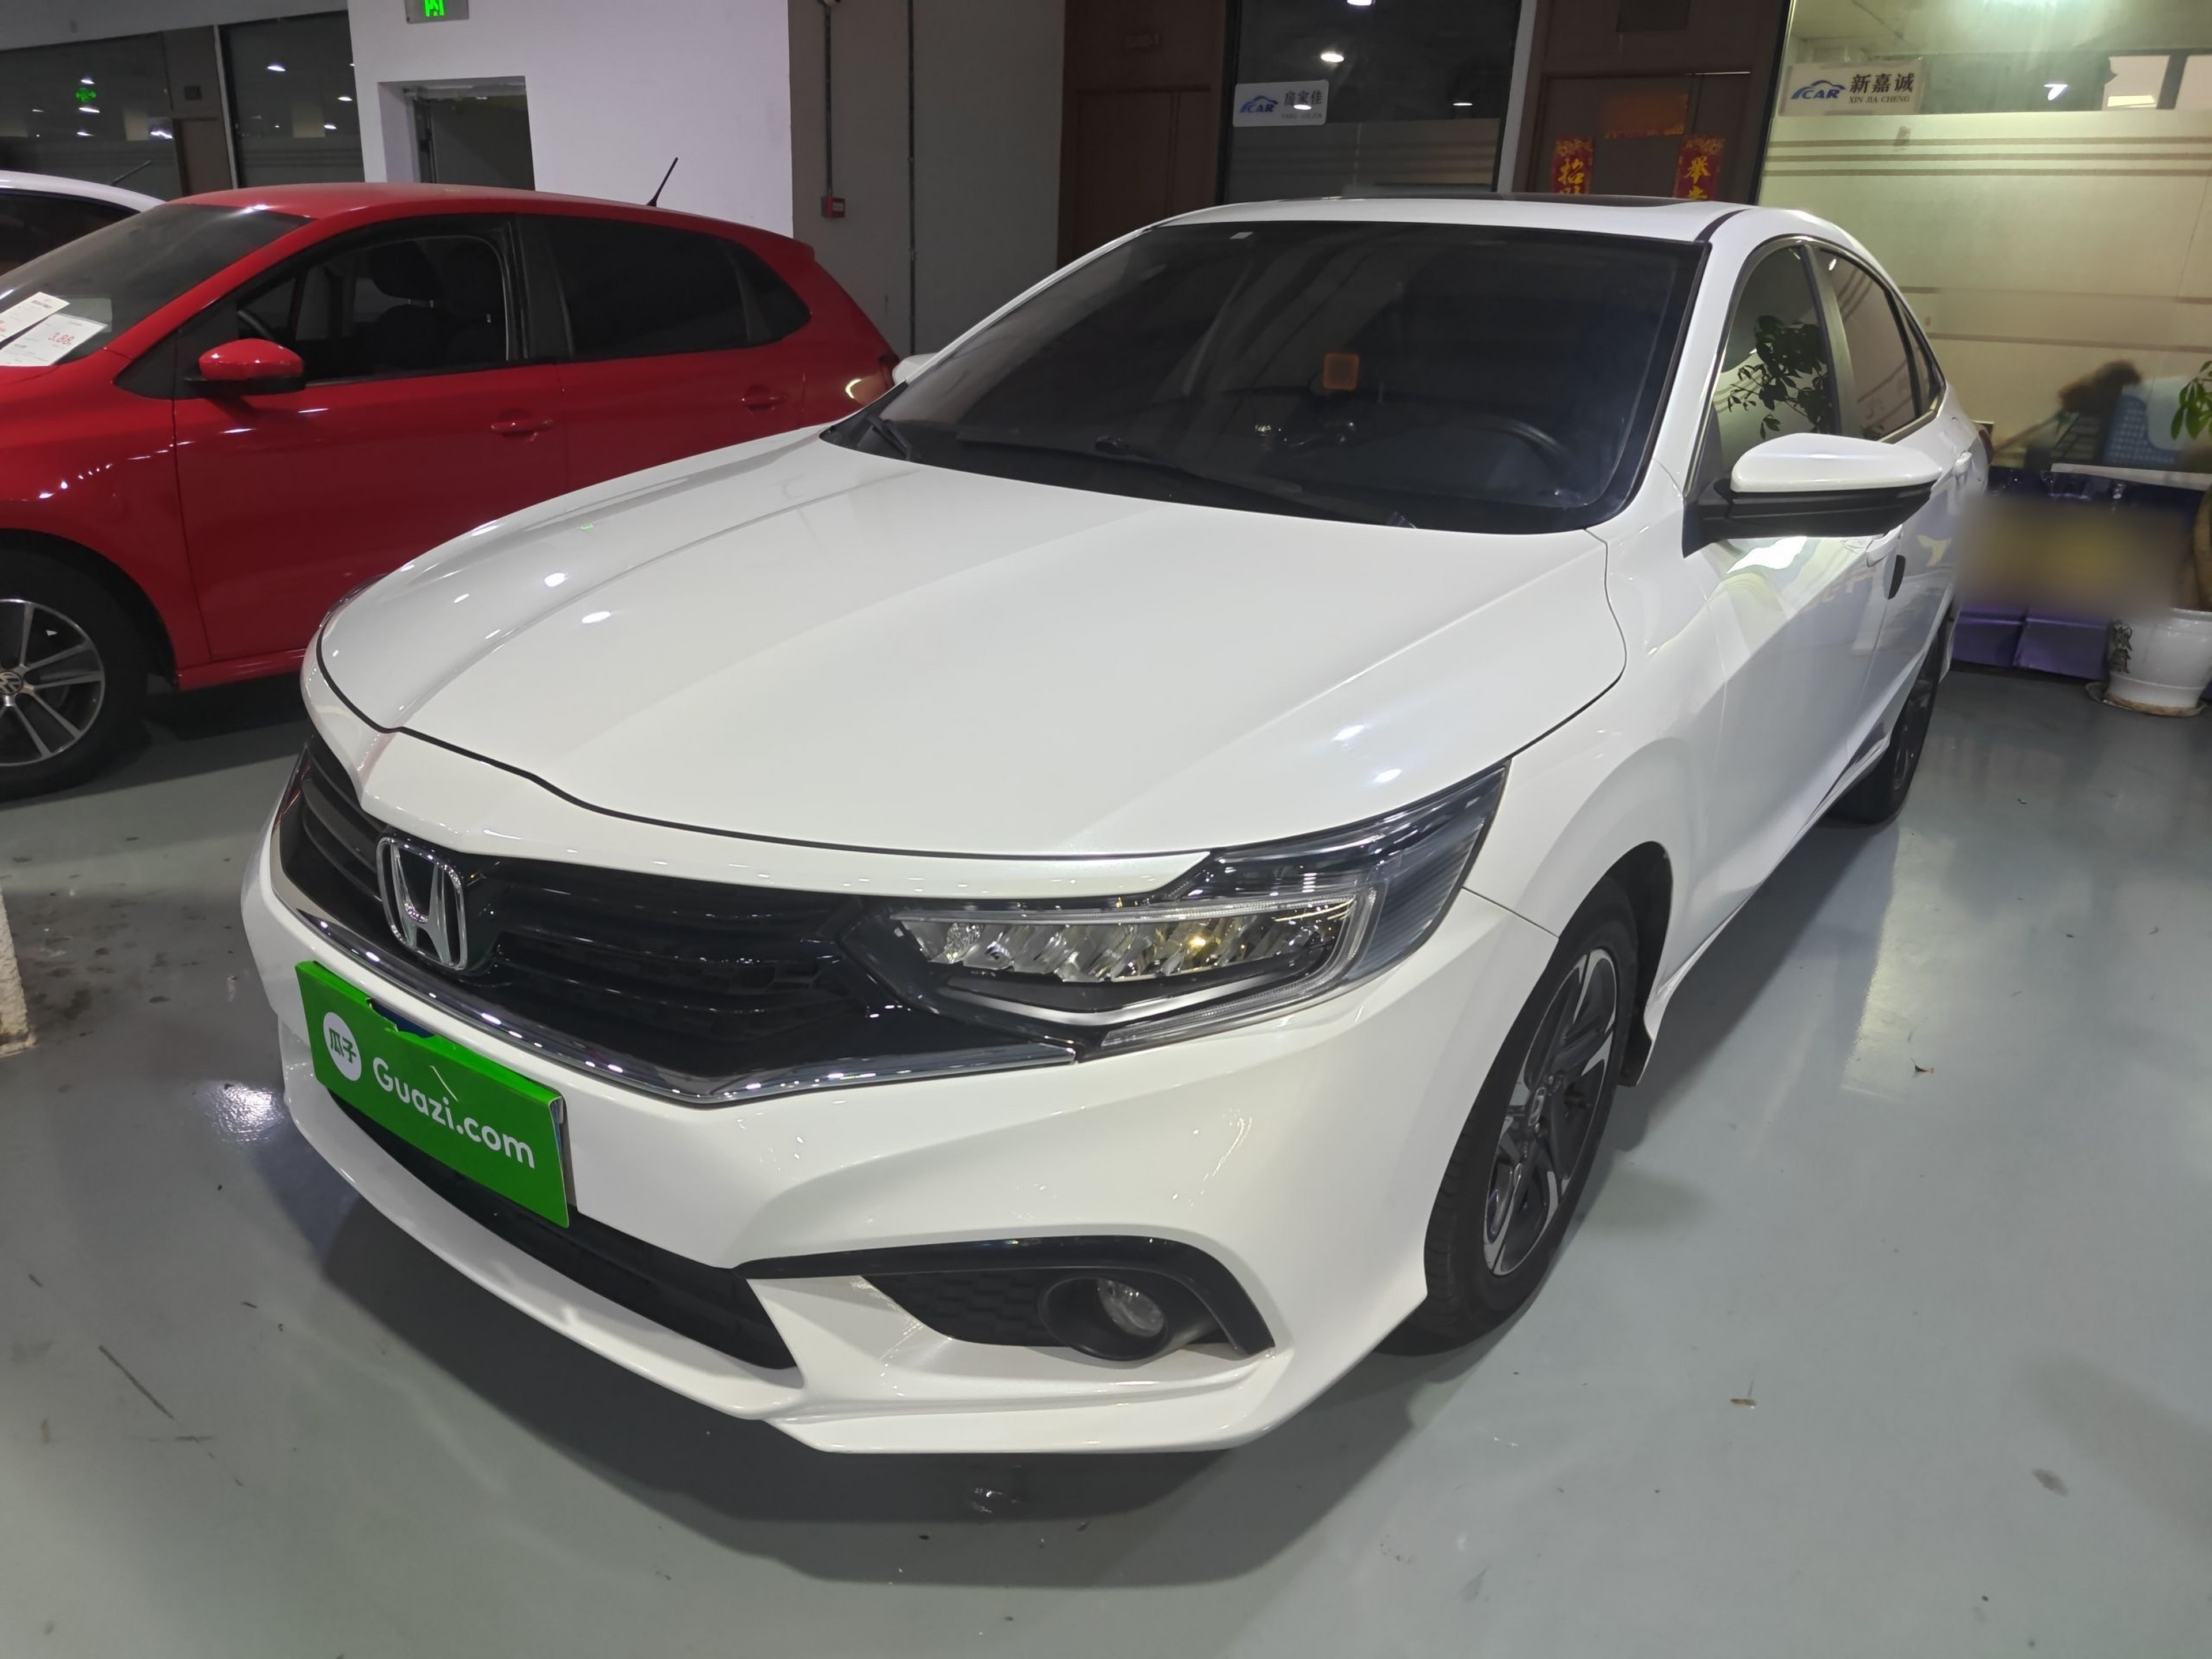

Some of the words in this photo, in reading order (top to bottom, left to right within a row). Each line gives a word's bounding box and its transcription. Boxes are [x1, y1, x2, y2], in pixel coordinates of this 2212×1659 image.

[1849, 96, 1863, 104] XIN
[1881, 95, 1910, 103] CHENG
[1850, 73, 1915, 93] 新嘉诚
[1558, 158, 1586, 194] 招
[328, 1025, 357, 1063] 瓜子
[373, 1056, 536, 1169] Guazi.com
